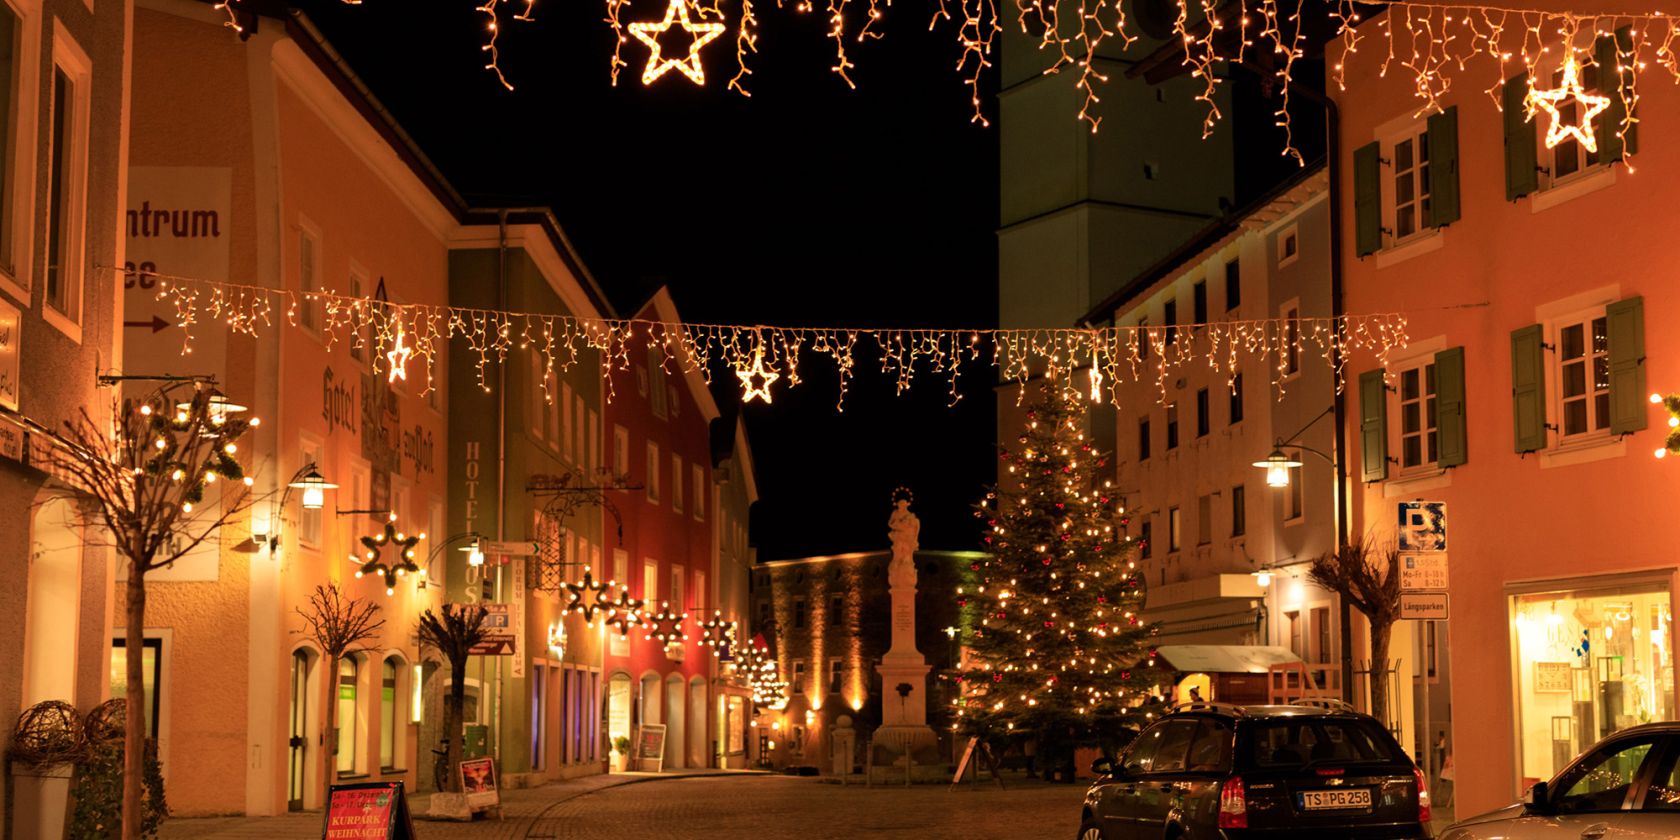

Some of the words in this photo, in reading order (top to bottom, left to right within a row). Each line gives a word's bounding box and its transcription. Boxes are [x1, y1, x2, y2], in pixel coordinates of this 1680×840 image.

[322, 365, 356, 435] Hotel
[515, 561, 523, 599] FORUM
[1403, 579, 1412, 588] Sa
[1404, 602, 1444, 612] Längsparken
[1305, 793, 1322, 806] TS
[1329, 793, 1346, 805] PG
[1348, 791, 1370, 804] 258
[331, 815, 381, 826] KURPARK
[327, 828, 387, 838] WEIHNACHT
